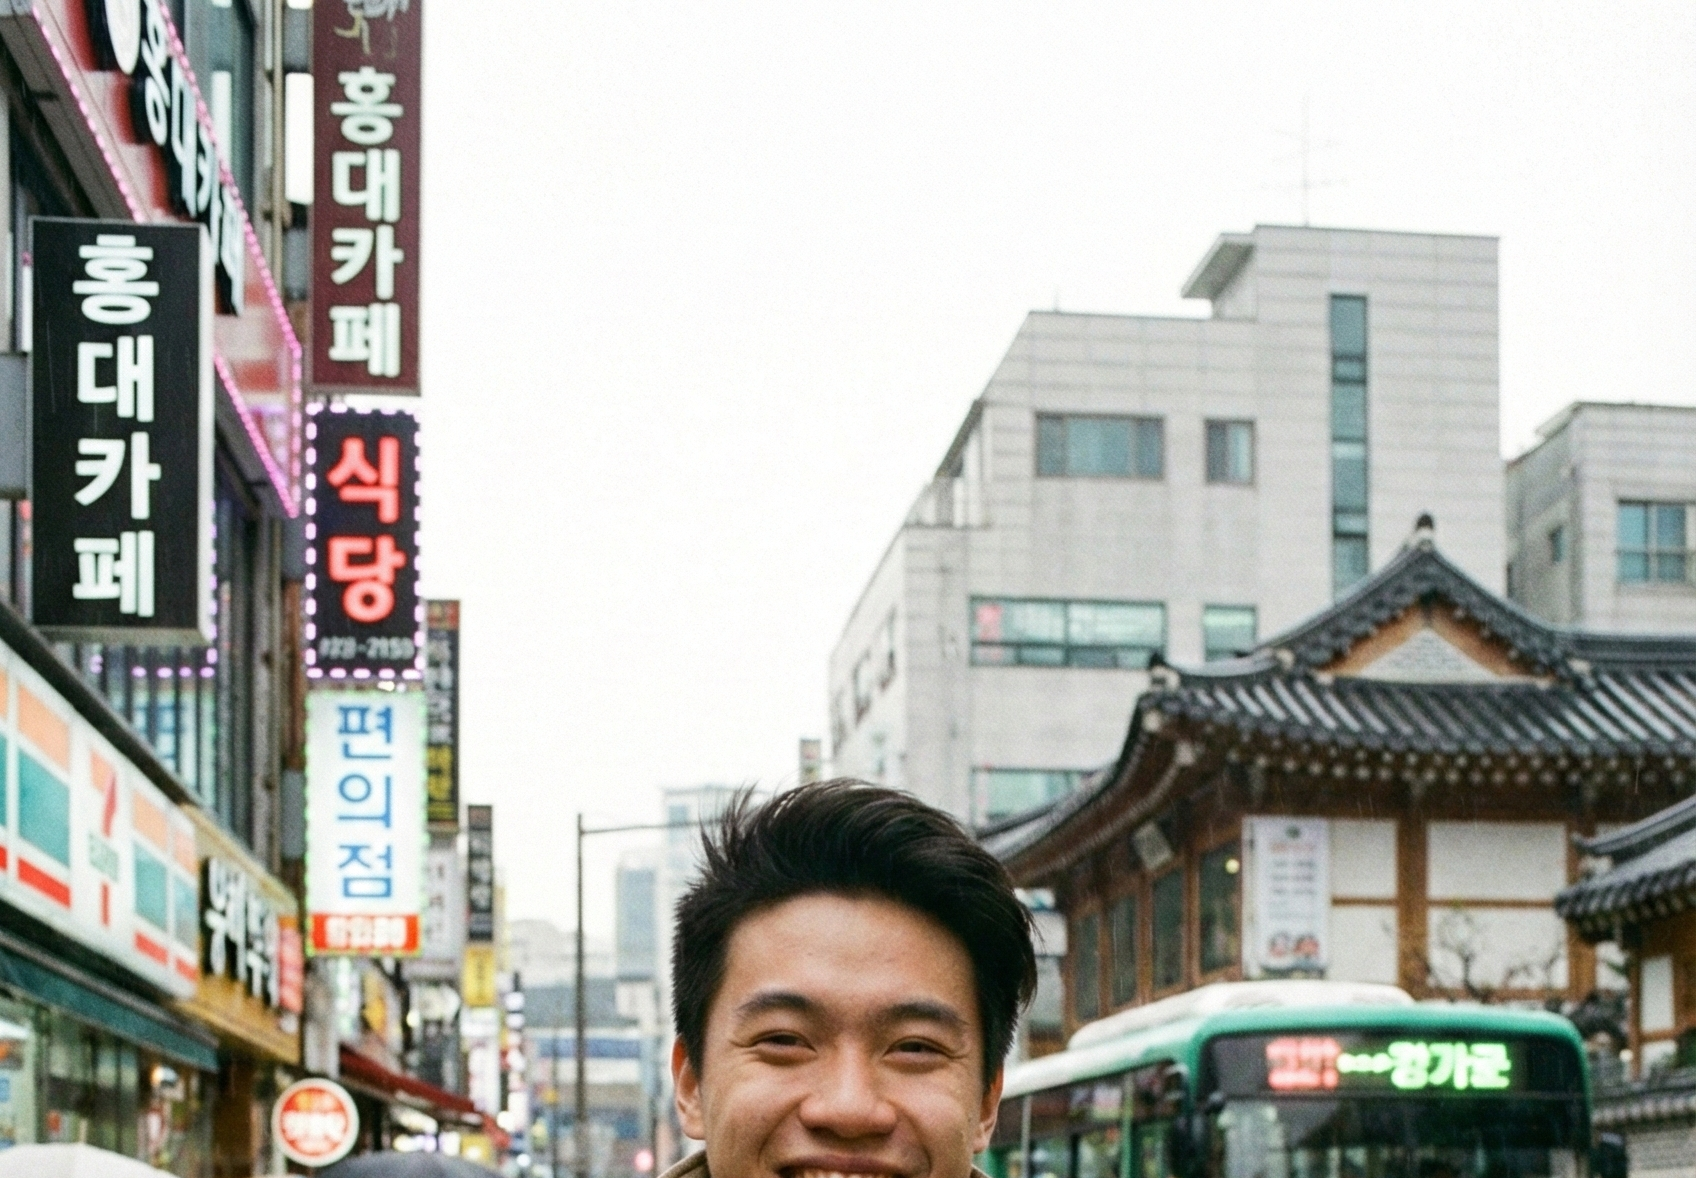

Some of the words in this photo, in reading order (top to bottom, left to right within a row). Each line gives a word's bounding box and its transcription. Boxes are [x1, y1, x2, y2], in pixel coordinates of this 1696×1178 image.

[330, 66, 404, 378] 홍대카페
[72, 233, 162, 618] 홍대카페
[326, 435, 407, 624] 식당
[336, 704, 394, 899] 편의점
